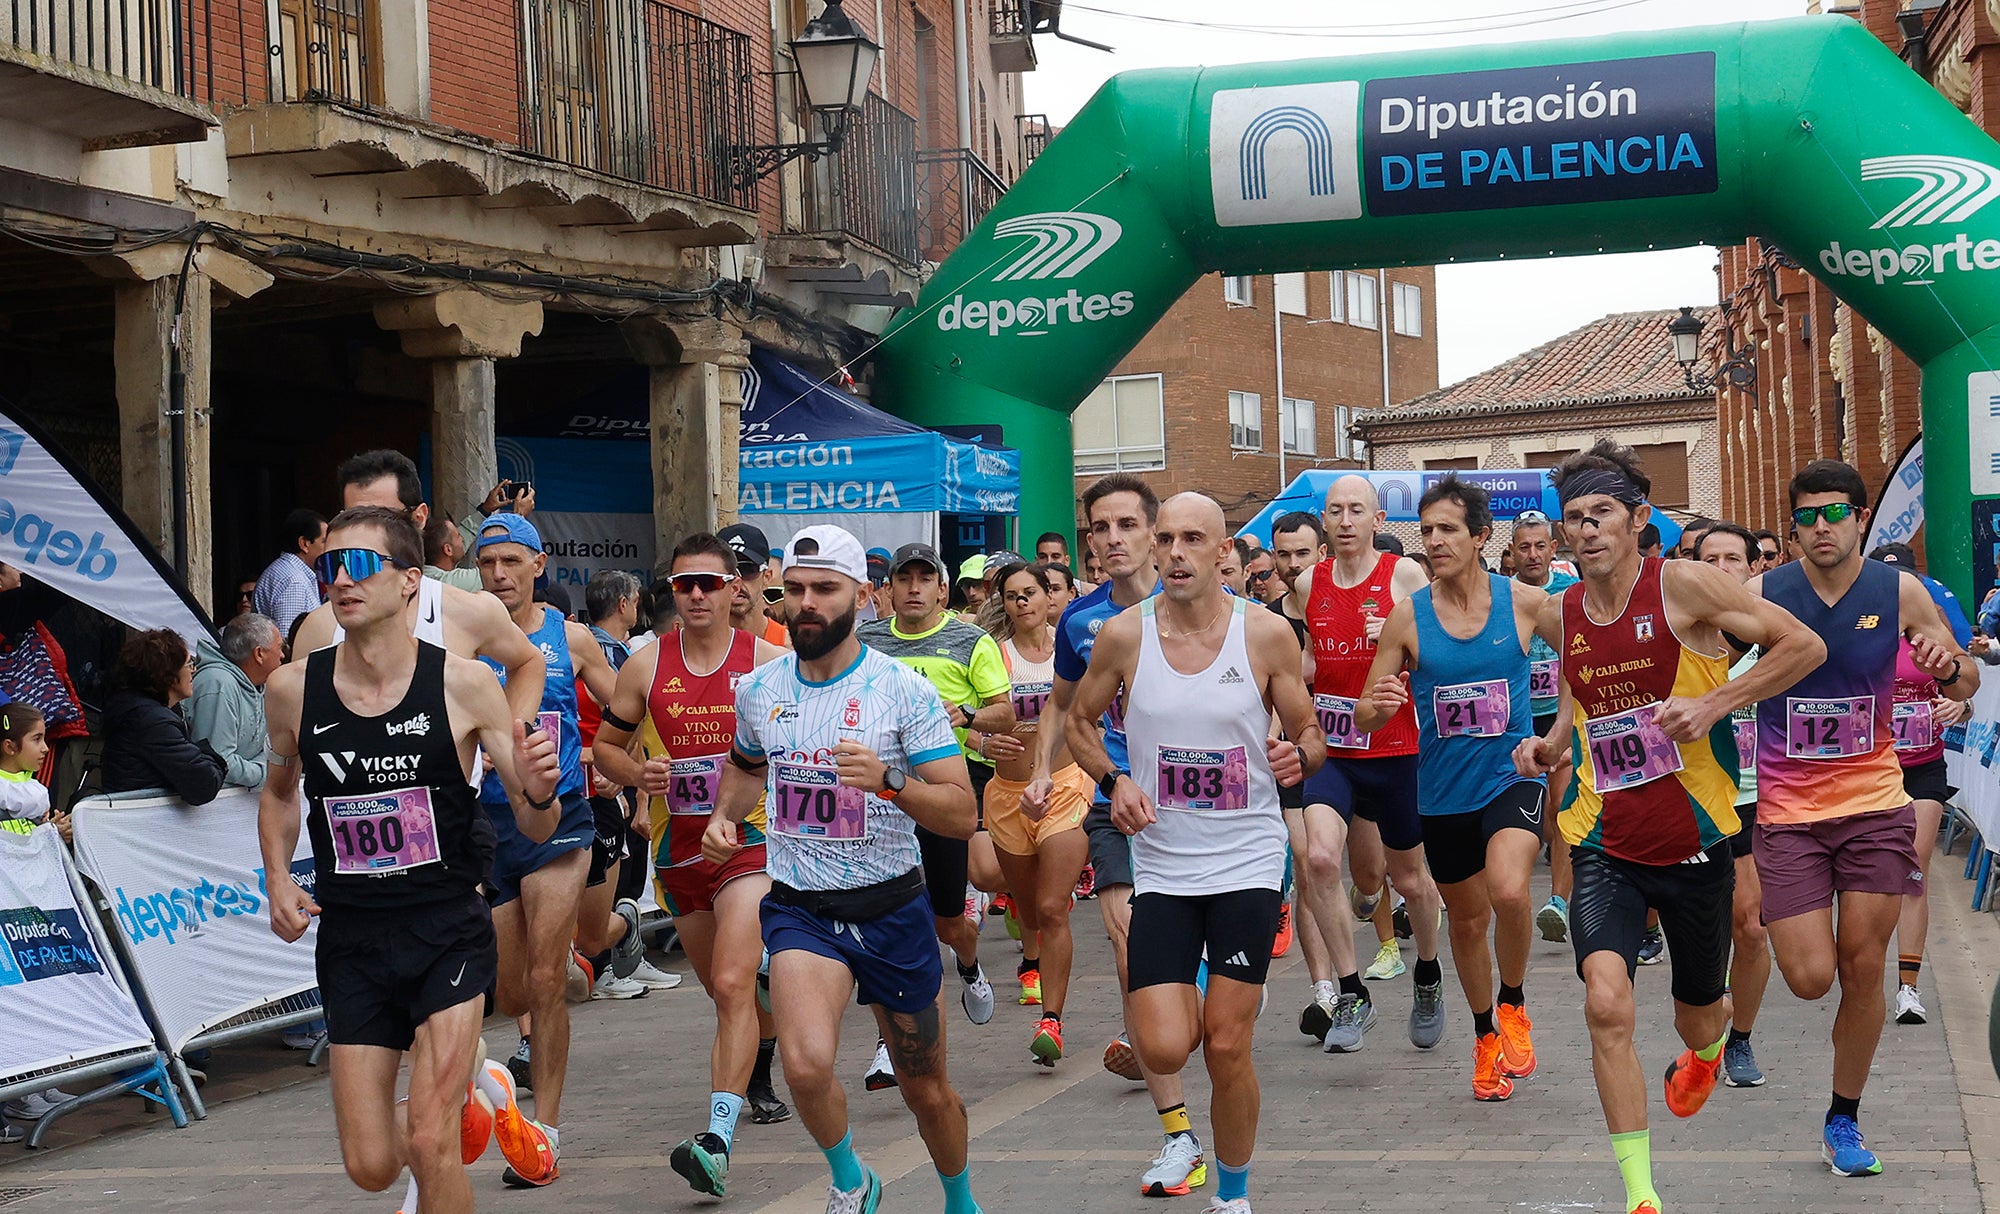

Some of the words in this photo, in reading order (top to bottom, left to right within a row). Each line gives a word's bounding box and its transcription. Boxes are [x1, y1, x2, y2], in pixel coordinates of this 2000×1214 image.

[1380, 81, 1637, 139] Diputación
[1381, 152, 1445, 191] DE
[1460, 133, 1704, 187] PALENCIA
[938, 289, 1135, 336] deportes
[1596, 663, 1621, 678] CAJA
[1622, 657, 1655, 672] RURAL
[1218, 677, 1245, 685] adidas
[1597, 680, 1637, 700] VINO
[686, 706, 708, 715] CAJA
[710, 704, 735, 714] RURA
[1446, 701, 1478, 727] 21
[1590, 703, 1609, 716] DE
[1610, 692, 1656, 711] TORO
[684, 720, 720, 733] VINO
[1317, 709, 1351, 736] 100
[1802, 717, 1840, 745] 12
[672, 735, 690, 746] DE
[693, 732, 733, 745] TORO
[360, 754, 422, 772] VICKY
[1177, 751, 1207, 759] 10.000
[1593, 733, 1647, 775] 149
[368, 771, 417, 784] FOODS
[789, 768, 819, 778] 10.000
[1162, 766, 1224, 799] 183
[676, 776, 709, 803] 43
[346, 800, 378, 810] 10.000
[778, 784, 836, 823] 170
[335, 815, 404, 857] 180
[115, 876, 260, 945] deportes
[18, 948, 40, 968] DE
